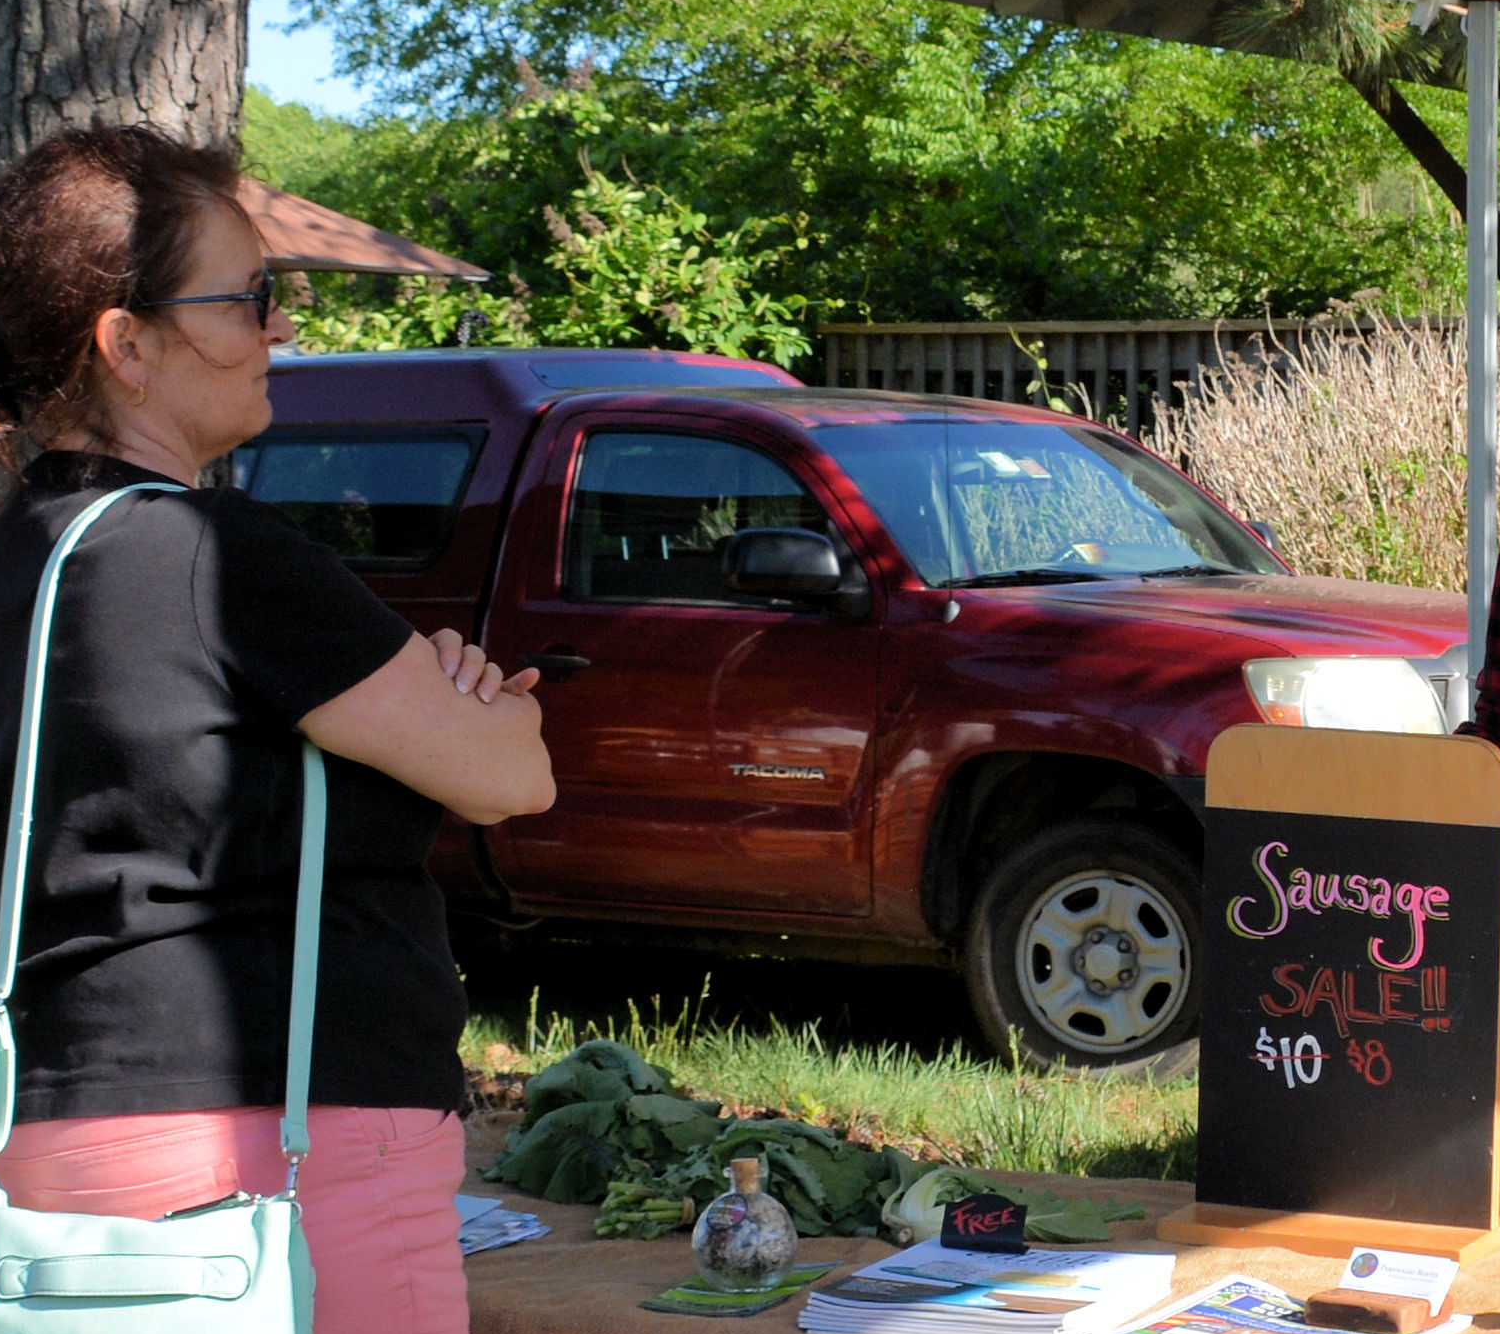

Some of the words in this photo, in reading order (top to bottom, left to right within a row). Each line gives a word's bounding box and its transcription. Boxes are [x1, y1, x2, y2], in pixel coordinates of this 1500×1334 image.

[729, 764, 825, 780] TACOMA
[1226, 841, 1450, 970] Sausage
[1259, 964, 1451, 1038] SALE!!
[1254, 1027, 1323, 1088] $10
[1347, 1038, 1392, 1085] $8
[951, 1202, 1017, 1236] FREE
